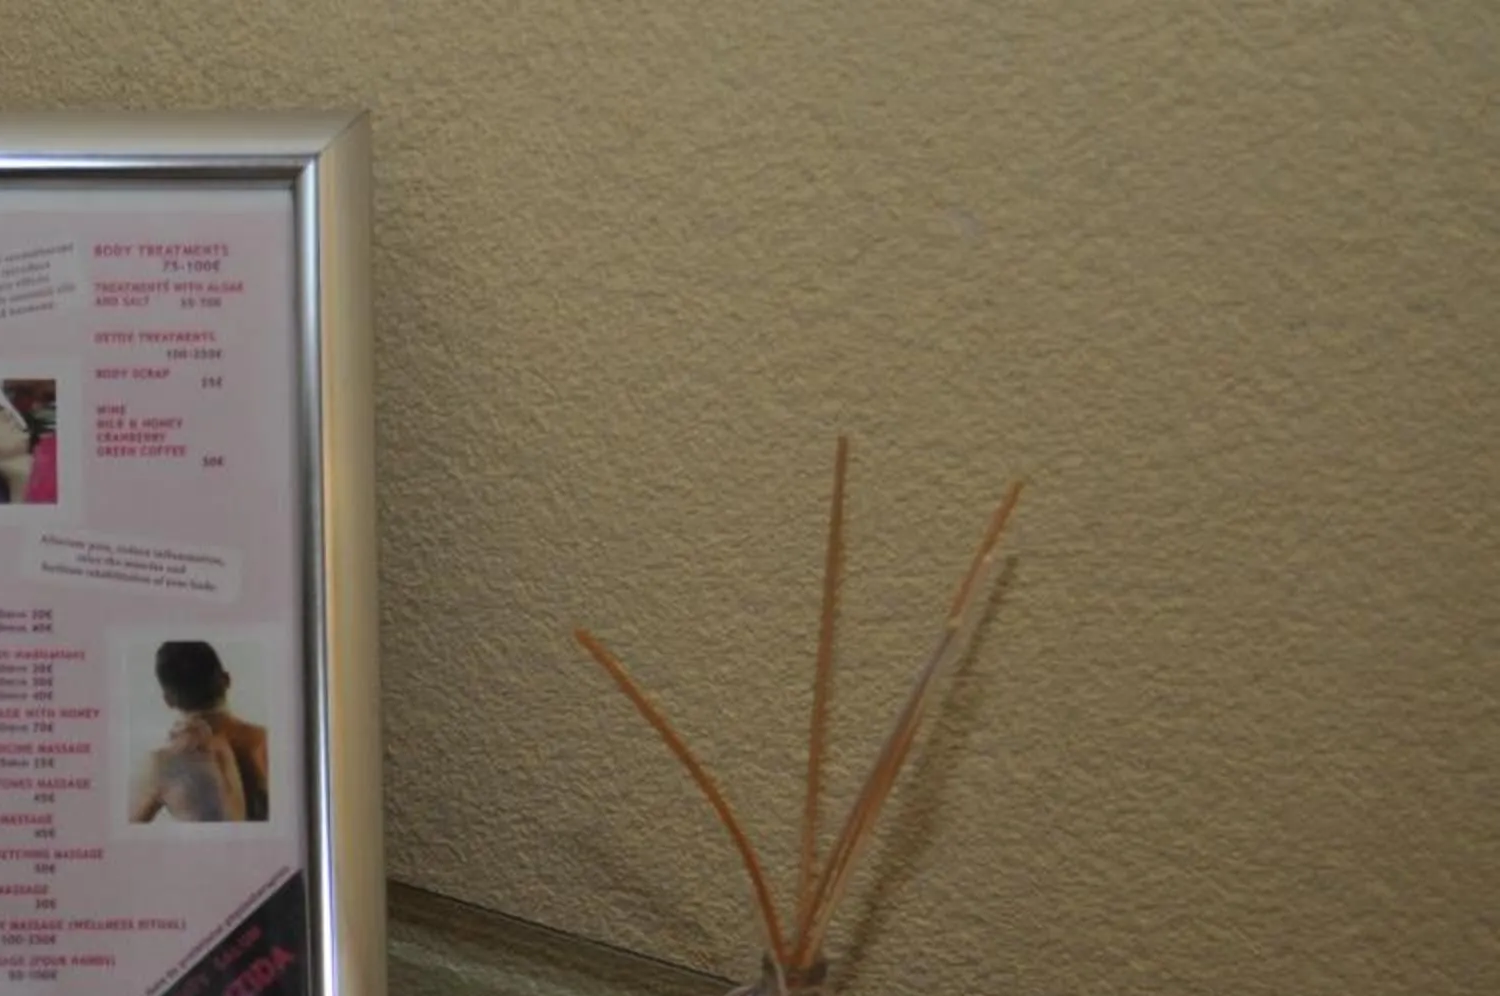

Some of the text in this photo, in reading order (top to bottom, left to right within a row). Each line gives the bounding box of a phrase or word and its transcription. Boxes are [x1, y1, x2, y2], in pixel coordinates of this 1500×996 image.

[93, 244, 229, 257] BODY TREATMENTS
[93, 281, 170, 293] TREATMENTS
[173, 281, 203, 293] WITH
[138, 331, 217, 343] TREATMENTS
[96, 445, 188, 457] GREEN COFFEE
[59, 708, 101, 719] HONEY
[37, 742, 92, 754] MASSAGE
[37, 778, 92, 790] MASSAGE
[0, 814, 53, 826] MASSAGE
[53, 849, 105, 860] MASSAGE
[8, 919, 64, 930] MASSAGE
